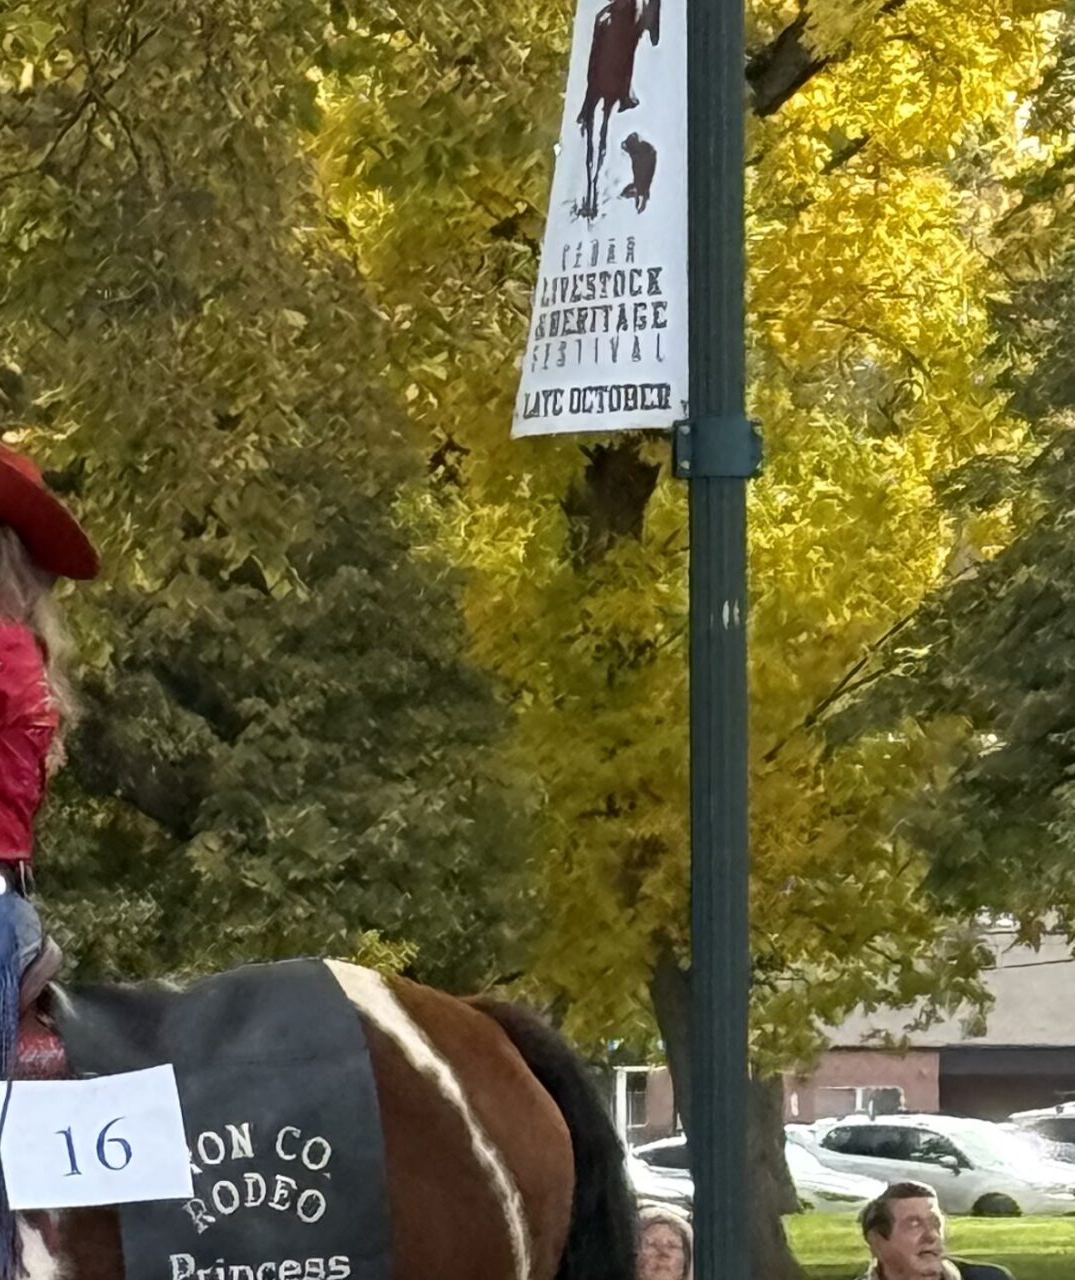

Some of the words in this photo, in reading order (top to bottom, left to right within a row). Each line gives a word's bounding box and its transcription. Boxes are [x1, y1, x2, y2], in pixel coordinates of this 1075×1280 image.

[541, 267, 663, 307] LIVESTOCK
[569, 383, 672, 414] OCTOBER
[55, 1116, 133, 1177] 16
[182, 1172, 327, 1234] RODEO
